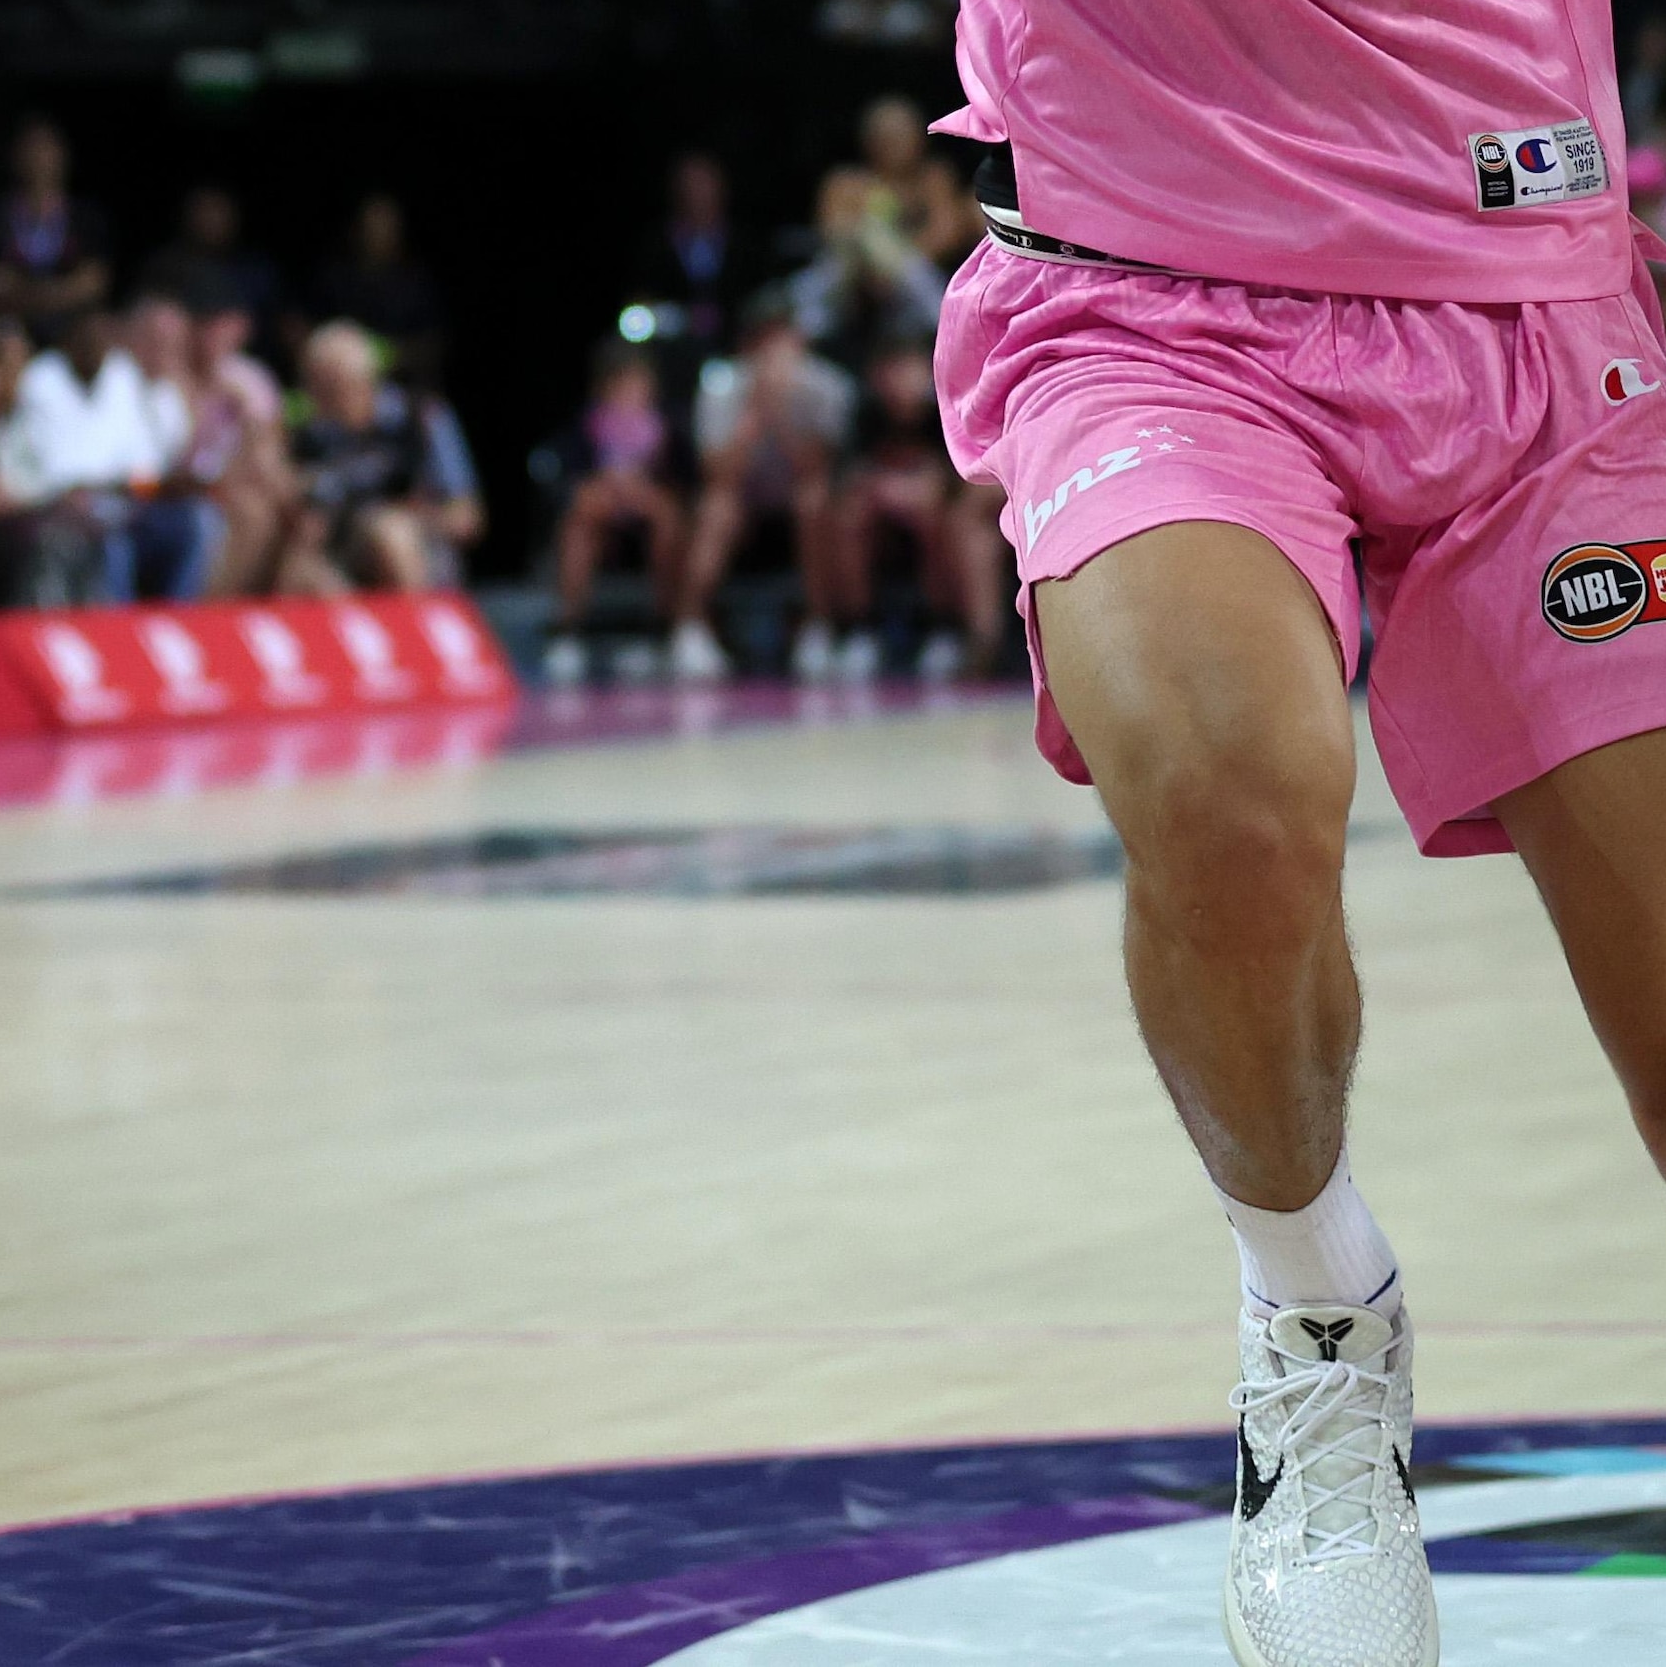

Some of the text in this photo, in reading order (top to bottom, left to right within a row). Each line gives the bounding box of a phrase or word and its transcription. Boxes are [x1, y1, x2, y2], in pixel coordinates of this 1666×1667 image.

[1481, 144, 1503, 161] NBL
[1565, 140, 1597, 159] SINCE
[1573, 156, 1595, 174] 1919
[1023, 446, 1142, 558] bnz
[1559, 568, 1627, 618] NBL
